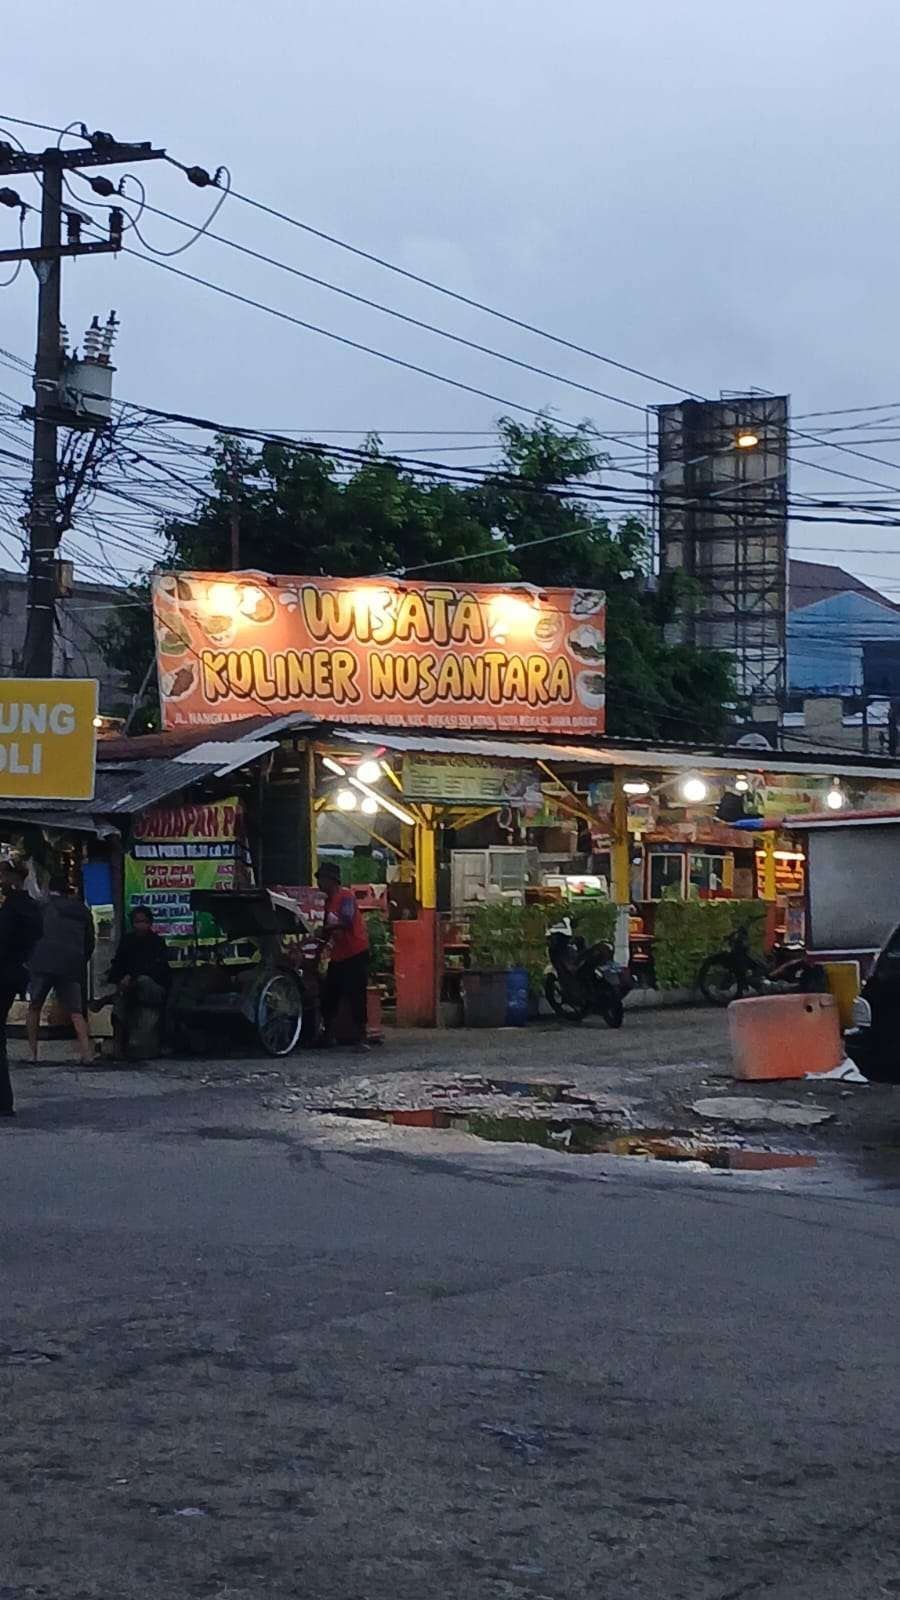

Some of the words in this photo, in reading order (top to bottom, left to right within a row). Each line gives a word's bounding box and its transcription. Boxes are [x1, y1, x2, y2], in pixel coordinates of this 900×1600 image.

[302, 586, 485, 648] WISATA
[202, 650, 361, 704] KULINER
[369, 652, 573, 706] NUSANTARA
[0, 702, 76, 735] UNG
[0, 743, 42, 774] LI
